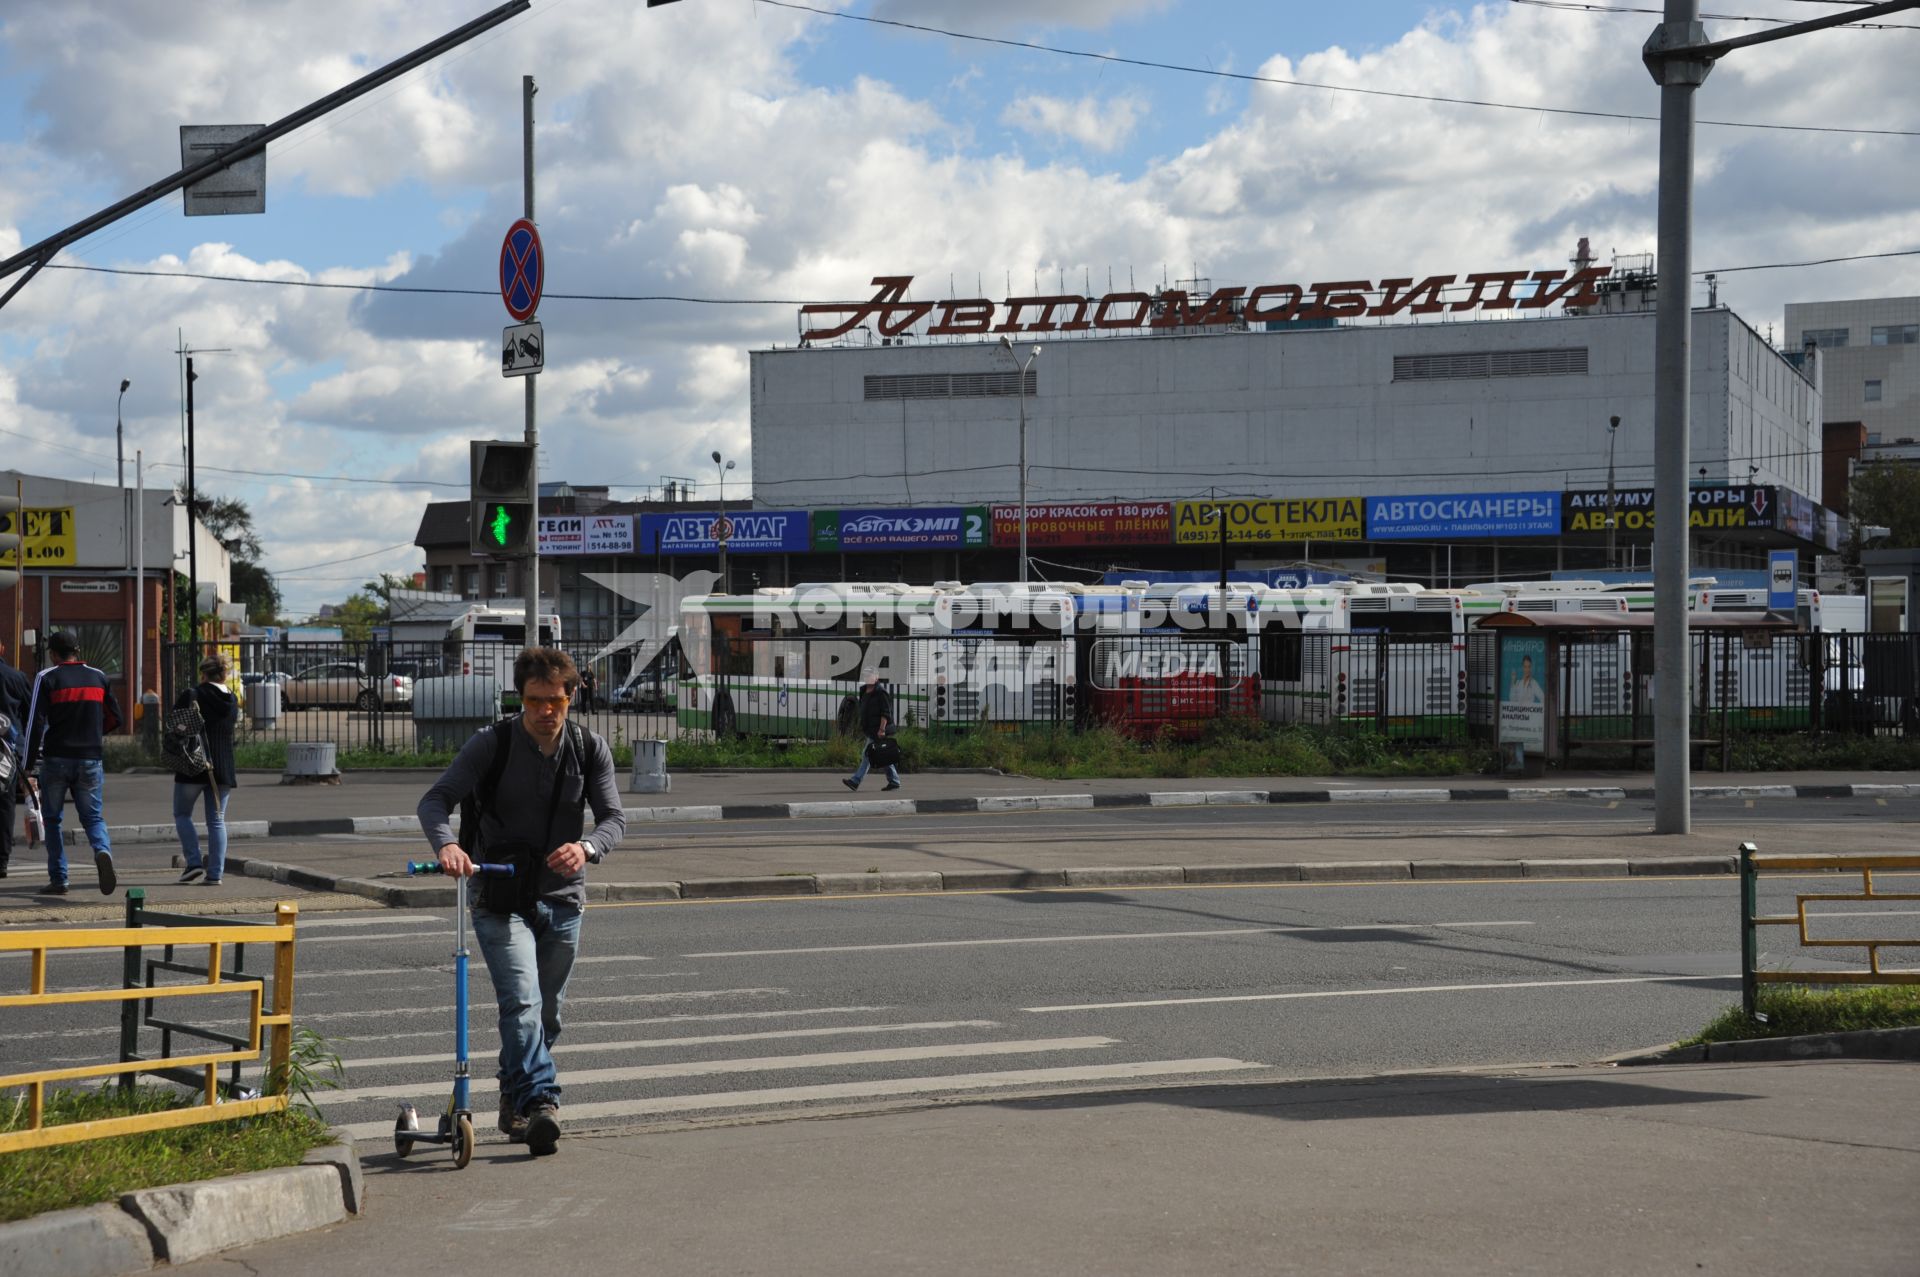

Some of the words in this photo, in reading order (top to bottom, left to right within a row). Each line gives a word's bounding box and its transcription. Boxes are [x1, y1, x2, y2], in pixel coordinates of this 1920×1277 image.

[1570, 489, 1745, 508] АККУМУТОРЫ
[1049, 507, 1098, 519] КРАСОК
[1100, 509, 1114, 517] от
[1117, 506, 1138, 517] 180
[1141, 504, 1168, 519] руб.
[1179, 500, 1359, 526] АВТОСТЕКЛА
[1373, 498, 1553, 521] АВТОСКАНЕРЫ
[662, 516, 787, 542] АВТОМАГ
[966, 515, 983, 538] 2
[1115, 518, 1169, 532] ПЛЁНКИ
[1373, 524, 1442, 533] WWW.CARMOD.RU
[1451, 523, 1496, 532] ПАВИЛЬОН
[1178, 530, 1208, 541] (495)
[1211, 529, 1271, 540] 72-14-66
[1337, 527, 1360, 538] 146
[717, 541, 783, 549] ТОМОБИЛИСТОВ
[843, 534, 863, 545] ВСЁ
[865, 534, 887, 544] ДЛЯ
[889, 534, 929, 543] ВАШЕГО
[931, 533, 958, 542] АВТО
[591, 541, 632, 551] 514-88-98
[1503, 639, 1545, 653] ИНВИТРО
[1502, 705, 1544, 715] МЕДИЦИНСКИЕ
[1502, 714, 1530, 722] АНАЛИЗЫ
